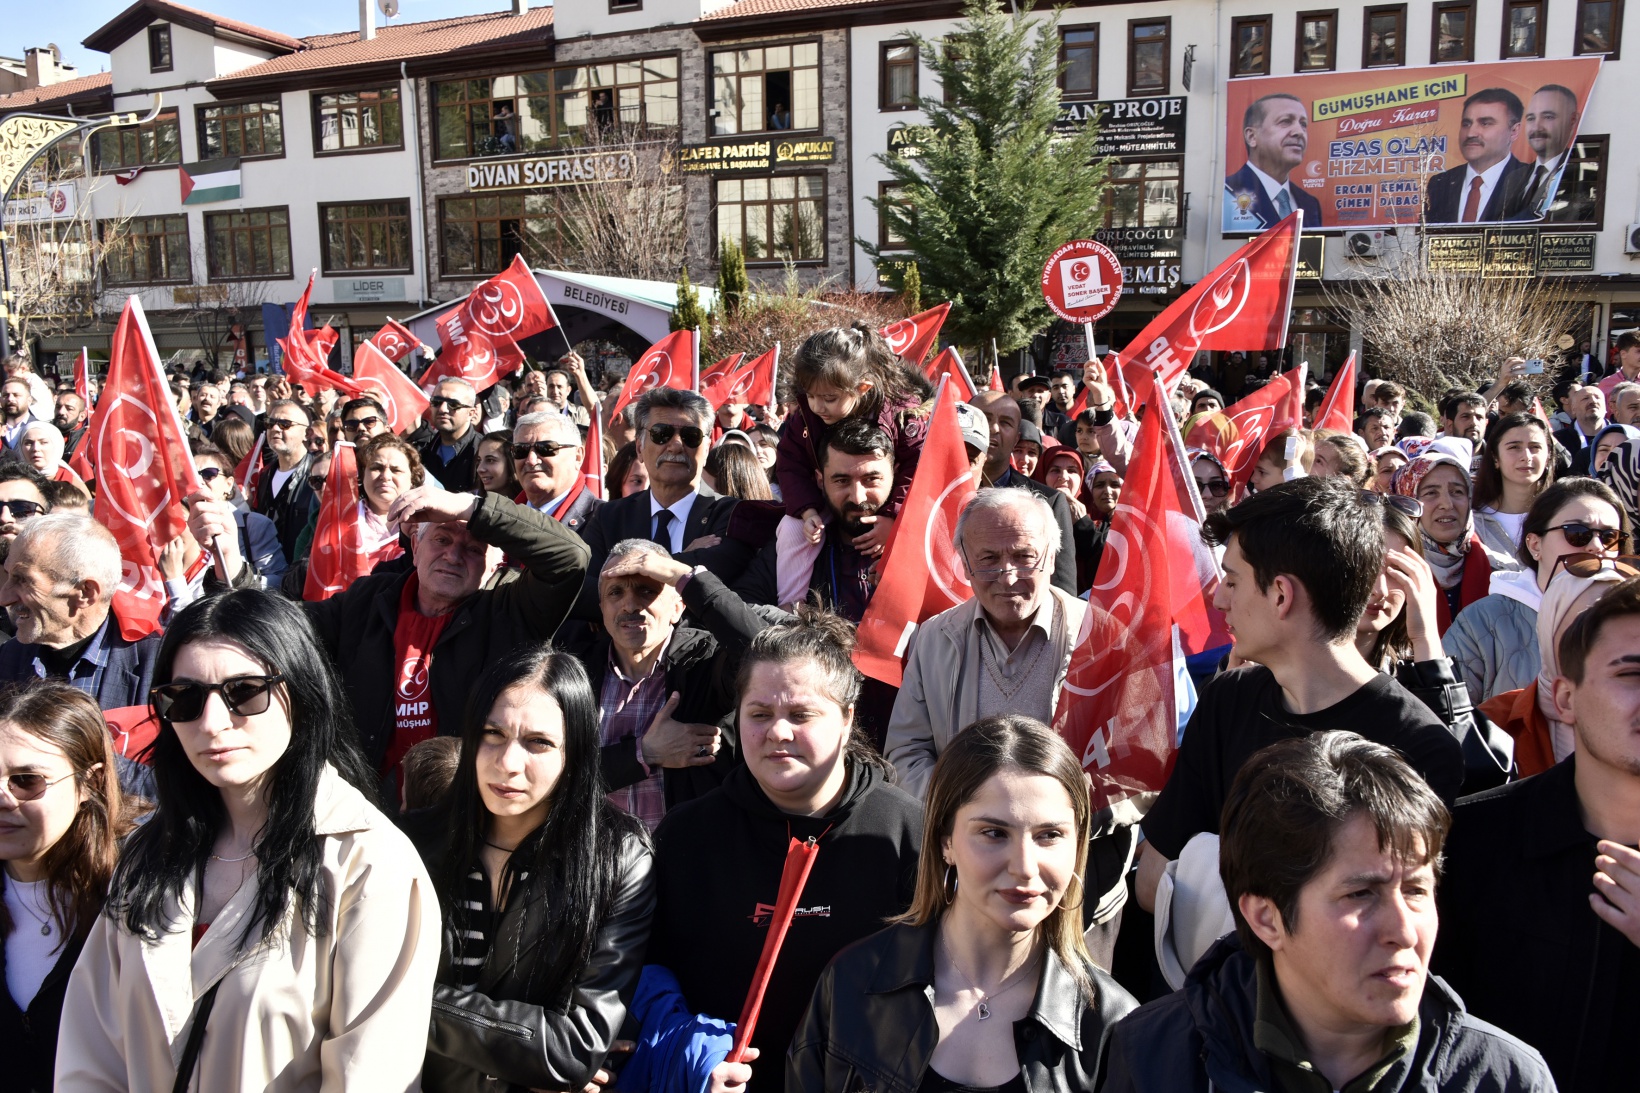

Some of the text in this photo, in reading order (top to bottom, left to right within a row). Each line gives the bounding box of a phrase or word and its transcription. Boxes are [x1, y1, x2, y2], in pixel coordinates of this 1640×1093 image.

[1318, 79, 1458, 116] GÜMÜŞHANE İÇİN
[1057, 103, 1098, 121] LAN
[1112, 99, 1182, 119] PROJE
[1337, 108, 1437, 134] Doğru Karar
[681, 141, 770, 160] ZAFER PARTİSİ
[794, 141, 834, 154] AVUKAT
[1329, 135, 1447, 158] ESAS OLAN
[1335, 184, 1373, 195] ERCAN
[1381, 182, 1419, 193] KEMAL
[1336, 197, 1371, 210] ÇİMEN
[1380, 194, 1419, 207] DABAĞ
[1096, 228, 1174, 242] ORUÇOĞLU
[1489, 234, 1534, 245] AVUKAT
[1541, 237, 1592, 246] AVUKAT
[1042, 241, 1121, 285] AYIRMADAN AYRIŞMADAN
[1122, 259, 1180, 289] EMİŞ
[353, 280, 384, 291] LİDER
[1089, 287, 1108, 295] BAŞER
[563, 285, 630, 315] BELEDİYESİ
[1045, 295, 1077, 322] GÜMÜŞHANE
[395, 701, 429, 716] MHP
[396, 718, 431, 729] MÜŞHAN
